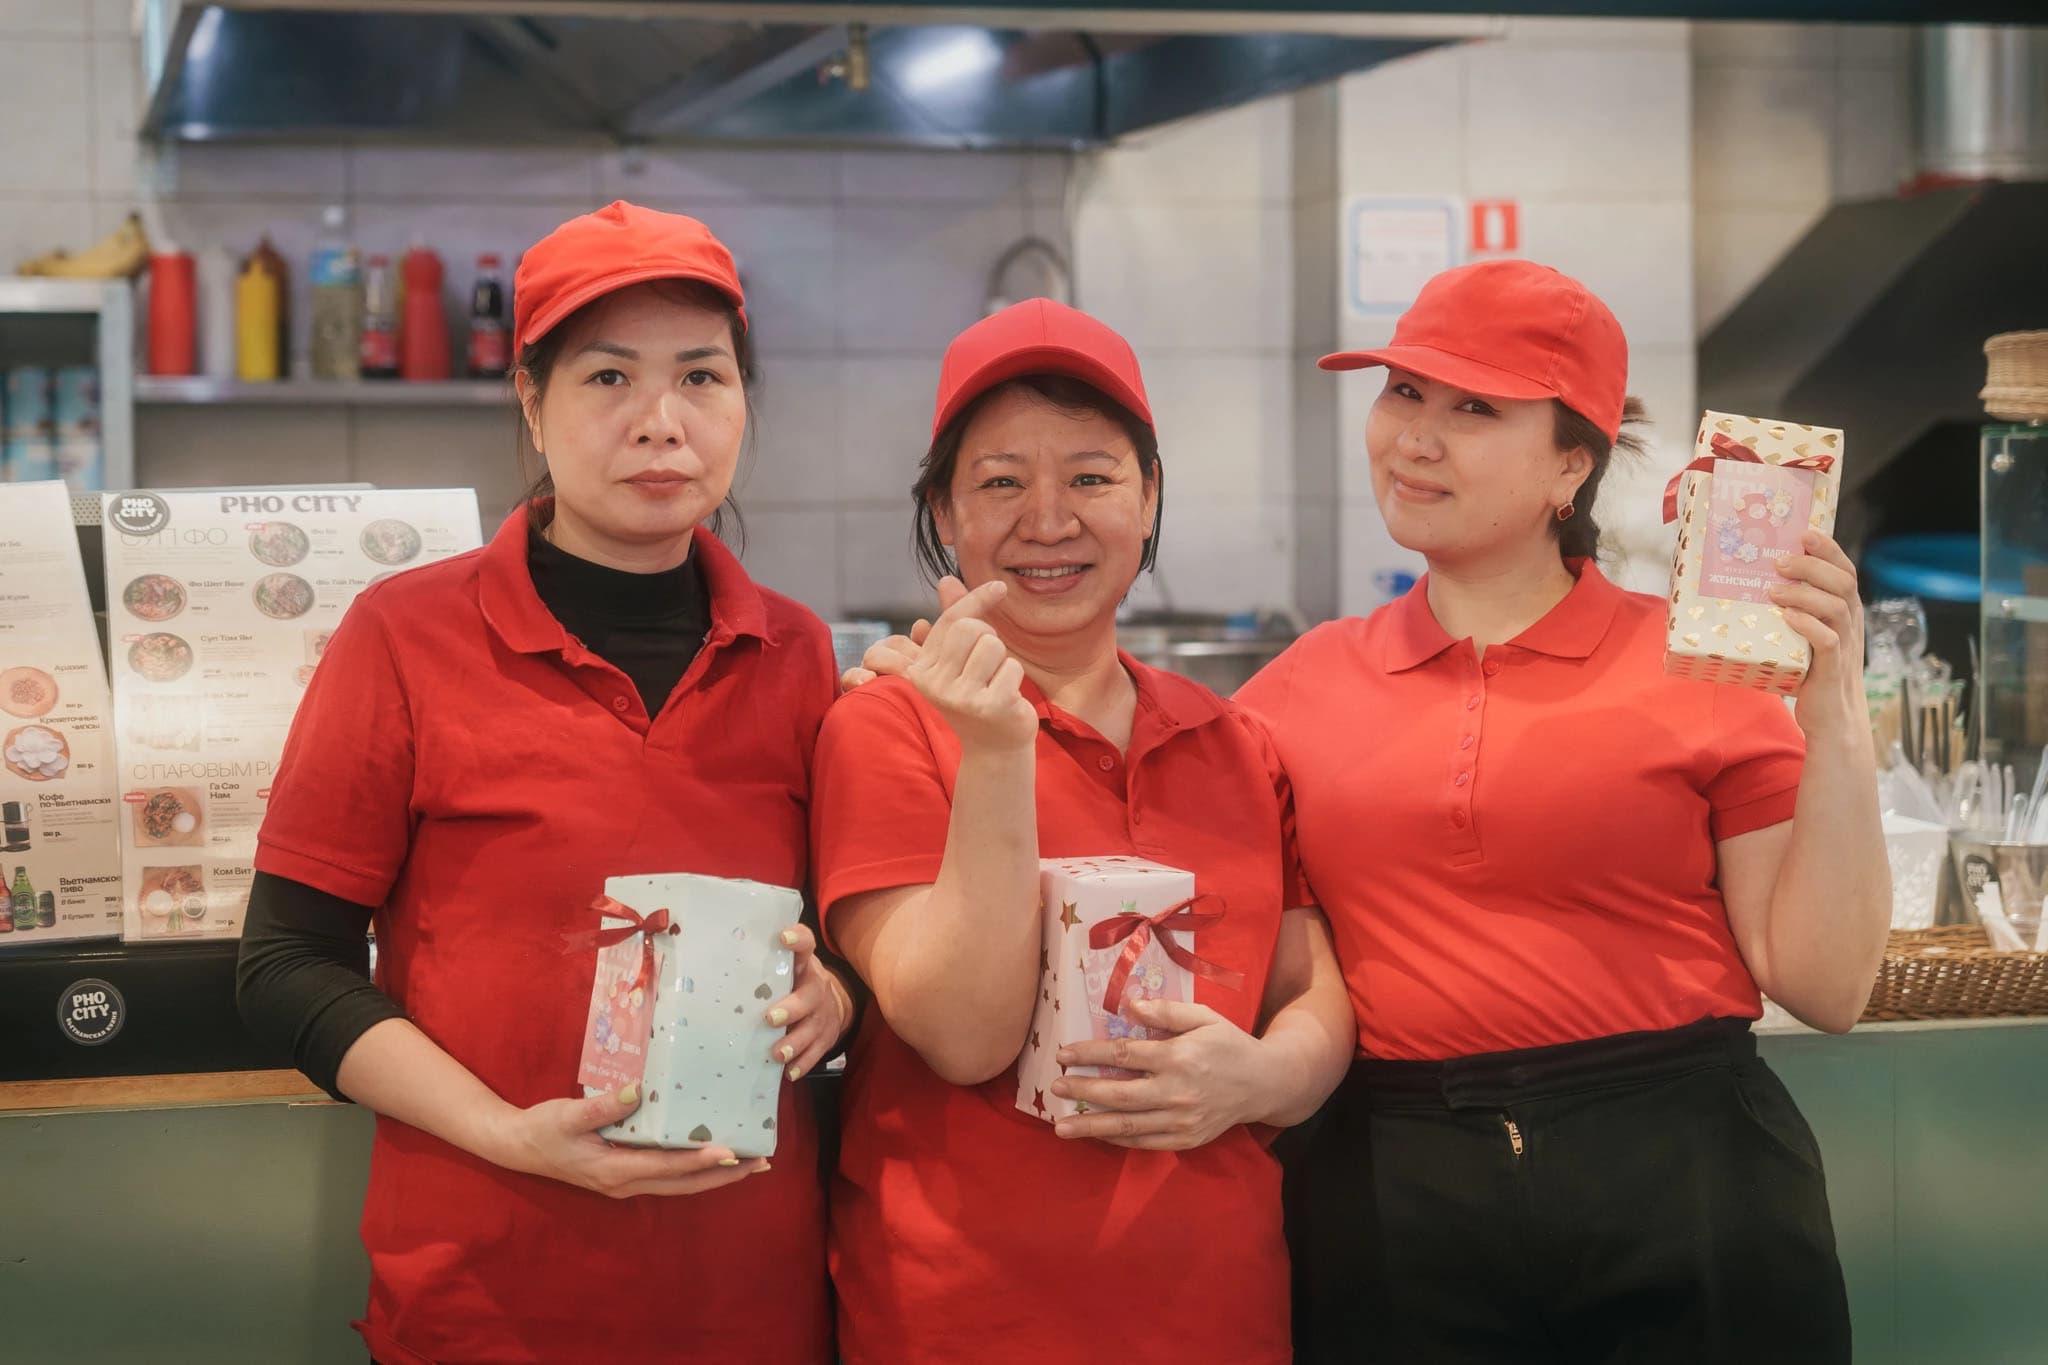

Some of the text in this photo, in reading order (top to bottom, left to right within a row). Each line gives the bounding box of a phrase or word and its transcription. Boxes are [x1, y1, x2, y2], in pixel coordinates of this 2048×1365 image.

[122, 498, 154, 508] PHO
[221, 495, 362, 513] PHO CITY
[120, 507, 157, 517] CITY
[184, 528, 228, 545] ФО
[1708, 573, 1761, 589] ЖЕНСКИЙ
[133, 764, 148, 779] С
[152, 762, 252, 780] ПАРОВЫМ
[38, 793, 65, 802] Кофе
[40, 798, 111, 808] по-вьетнамски
[214, 868, 233, 876] Ком
[72, 991, 106, 1007] PHO
[72, 1003, 110, 1021] CITY
